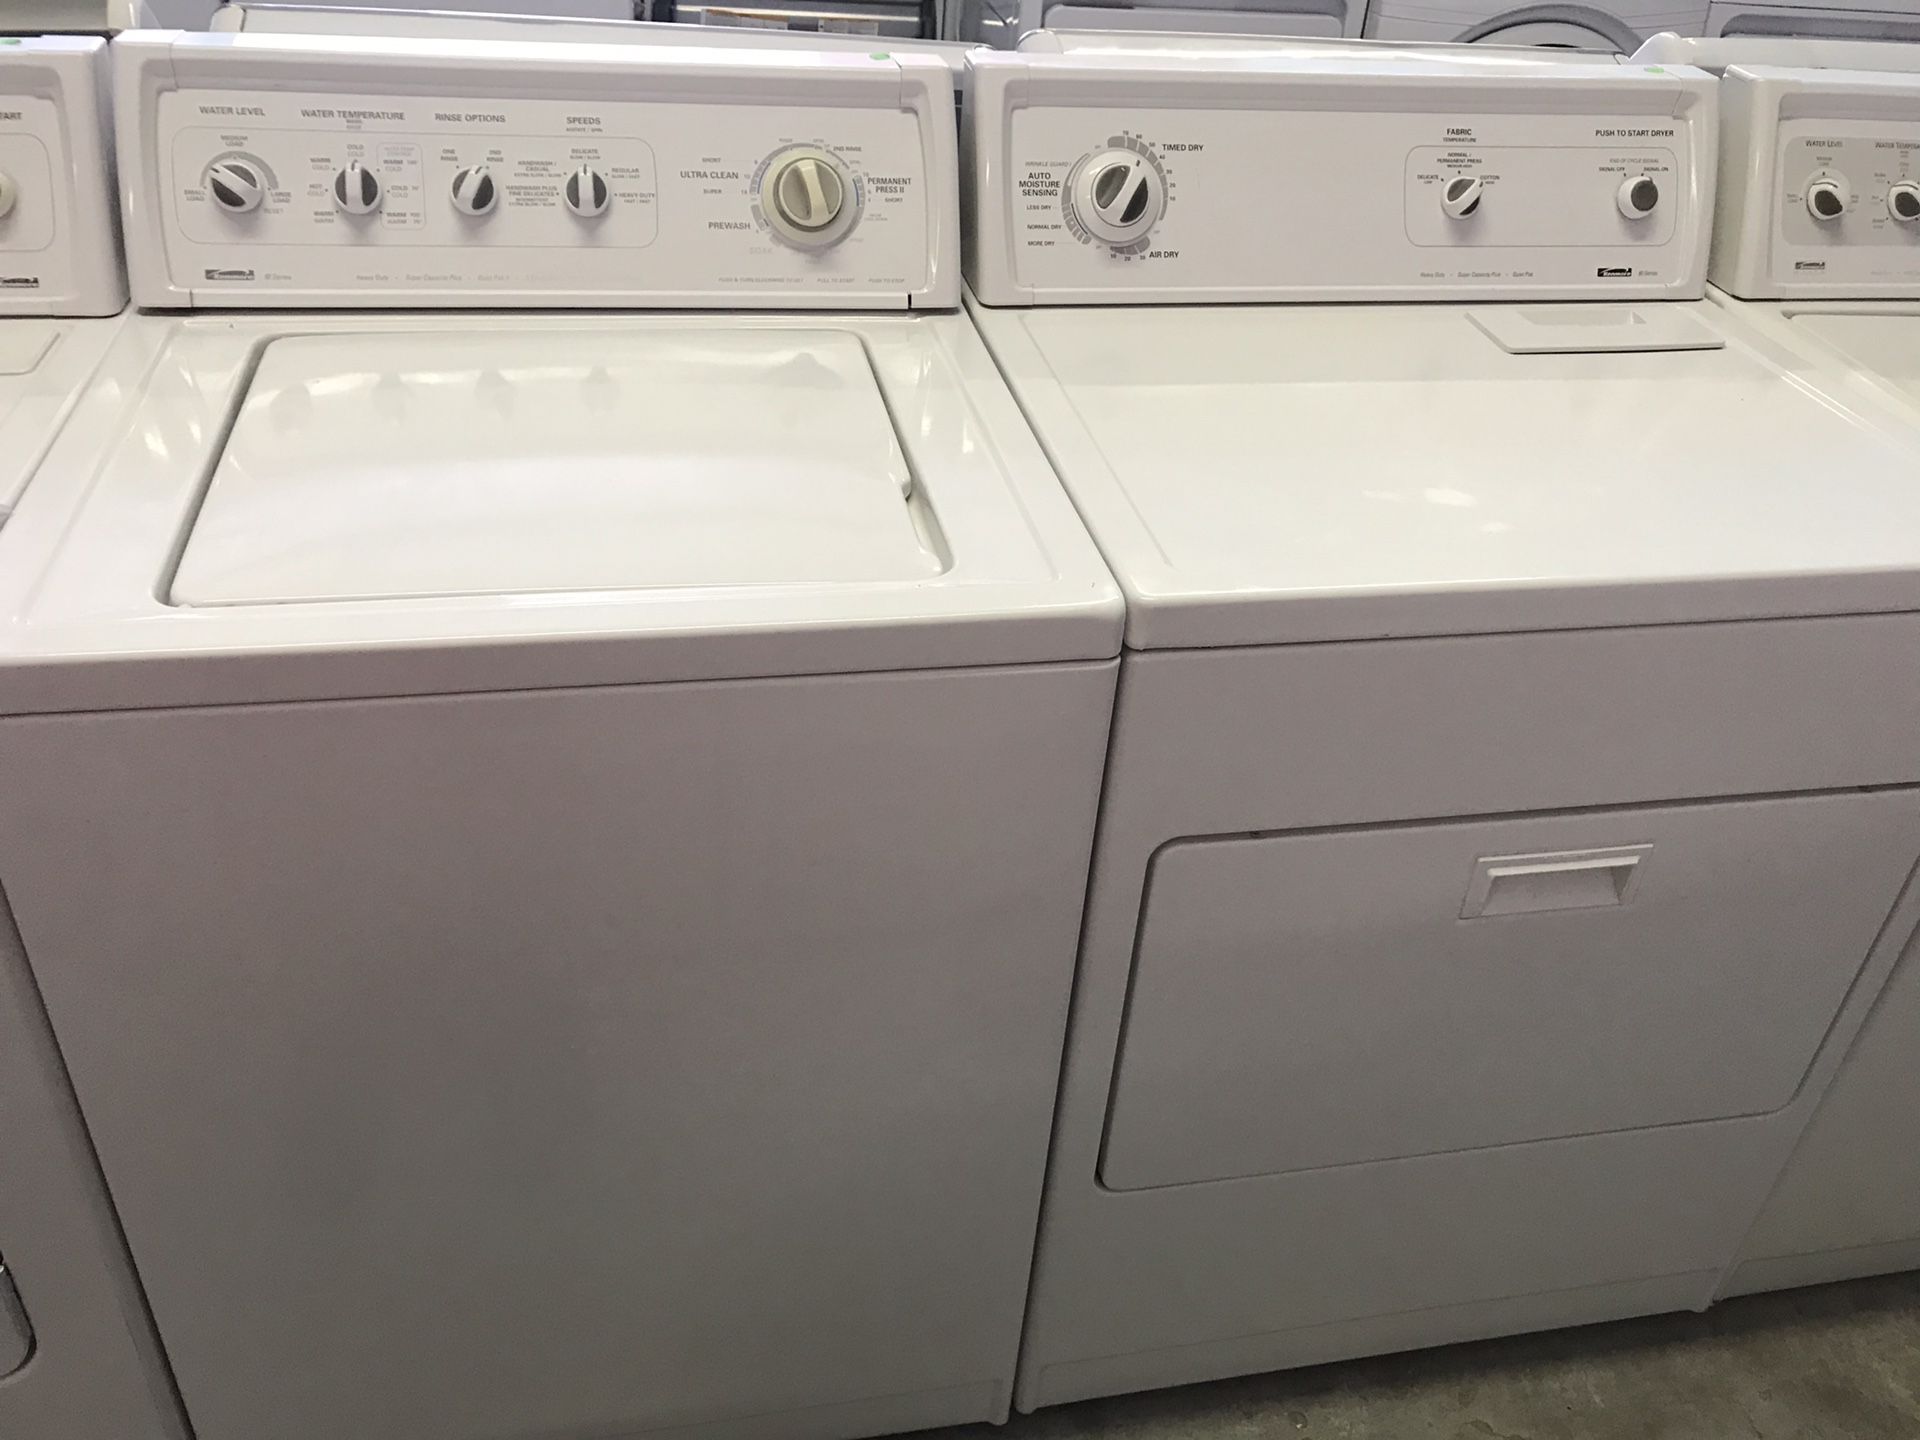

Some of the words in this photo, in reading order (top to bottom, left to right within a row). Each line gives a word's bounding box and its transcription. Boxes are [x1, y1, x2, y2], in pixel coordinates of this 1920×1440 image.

[199, 105, 234, 116] WATER
[235, 107, 266, 117] LEVEL
[300, 109, 335, 119] WATER
[336, 110, 406, 121] TEMPERATURE
[434, 112, 463, 122] RINSE
[464, 113, 507, 123] OPTIONS
[566, 116, 602, 125] SPEEDS
[1446, 128, 1472, 136] FABRIC
[1595, 129, 1615, 137] PUSH
[1616, 129, 1627, 137] TO
[1627, 129, 1650, 137] START
[1650, 129, 1674, 137] DRYER
[1161, 143, 1187, 152] TIMED
[1187, 144, 1204, 152] DRY
[680, 170, 709, 179] ULTRA
[710, 171, 739, 180] CLEAN
[1028, 172, 1051, 180] AUTO
[867, 177, 912, 187] PERMANENT
[1018, 180, 1061, 189] MOISTURE
[875, 186, 898, 195] PRESS
[1022, 188, 1058, 197] SENSING
[708, 221, 752, 231] PREWASH
[1148, 251, 1163, 259] AIR
[1163, 251, 1180, 259] DRY
